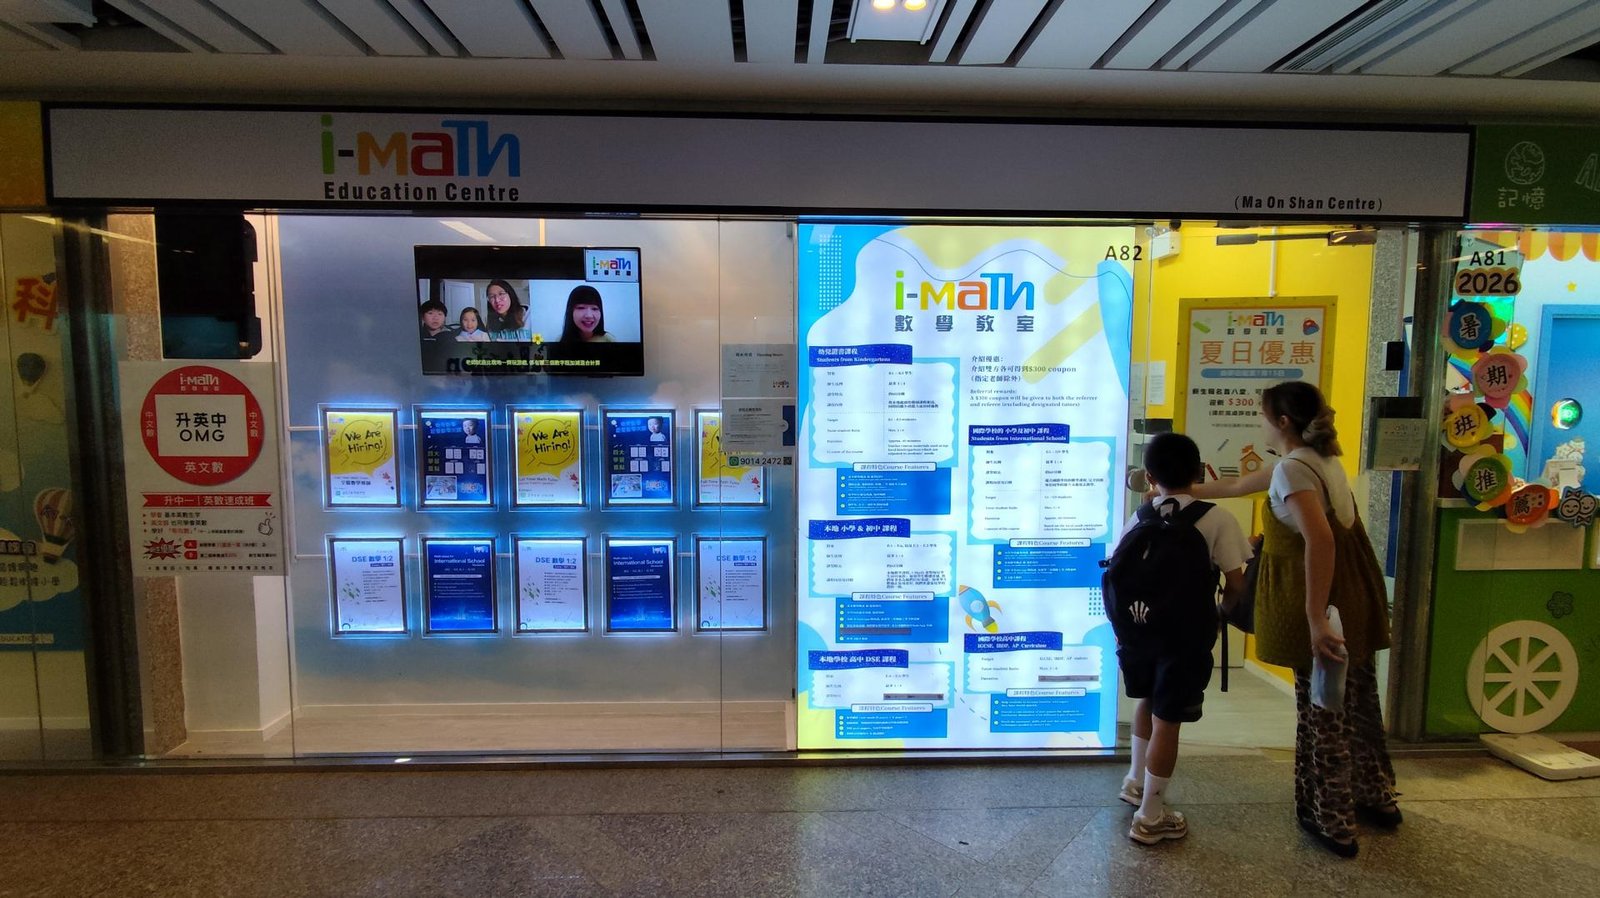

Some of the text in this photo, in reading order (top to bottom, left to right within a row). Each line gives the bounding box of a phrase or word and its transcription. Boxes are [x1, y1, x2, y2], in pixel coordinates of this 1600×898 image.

[325, 182, 519, 201] Education Centre
[1498, 188, 1545, 209] 記憶
[1234, 195, 1382, 211] (Ma On Shan Centre)
[1105, 246, 1142, 261] A82
[1470, 251, 1506, 266] A81
[1458, 271, 1519, 294] 2026
[895, 315, 1034, 332] 數學教室
[1460, 313, 1481, 338] 暑
[1200, 340, 1316, 365] 夏日優惠
[1047, 366, 1077, 374] coupon
[1487, 365, 1508, 386] 期
[1228, 398, 1254, 407] $300
[176, 412, 227, 428] 升英中
[1455, 416, 1476, 437] 班
[179, 429, 225, 442] OMG
[344, 429, 381, 442] We Are
[531, 428, 570, 443] We Are
[347, 441, 384, 454] Hiring!
[534, 441, 571, 454] Hiring!
[184, 461, 224, 474] 英文數
[740, 457, 782, 465] 9014 2472
[1475, 469, 1496, 491] 推
[841, 525, 856, 533] 小學
[882, 525, 898, 533] 課程
